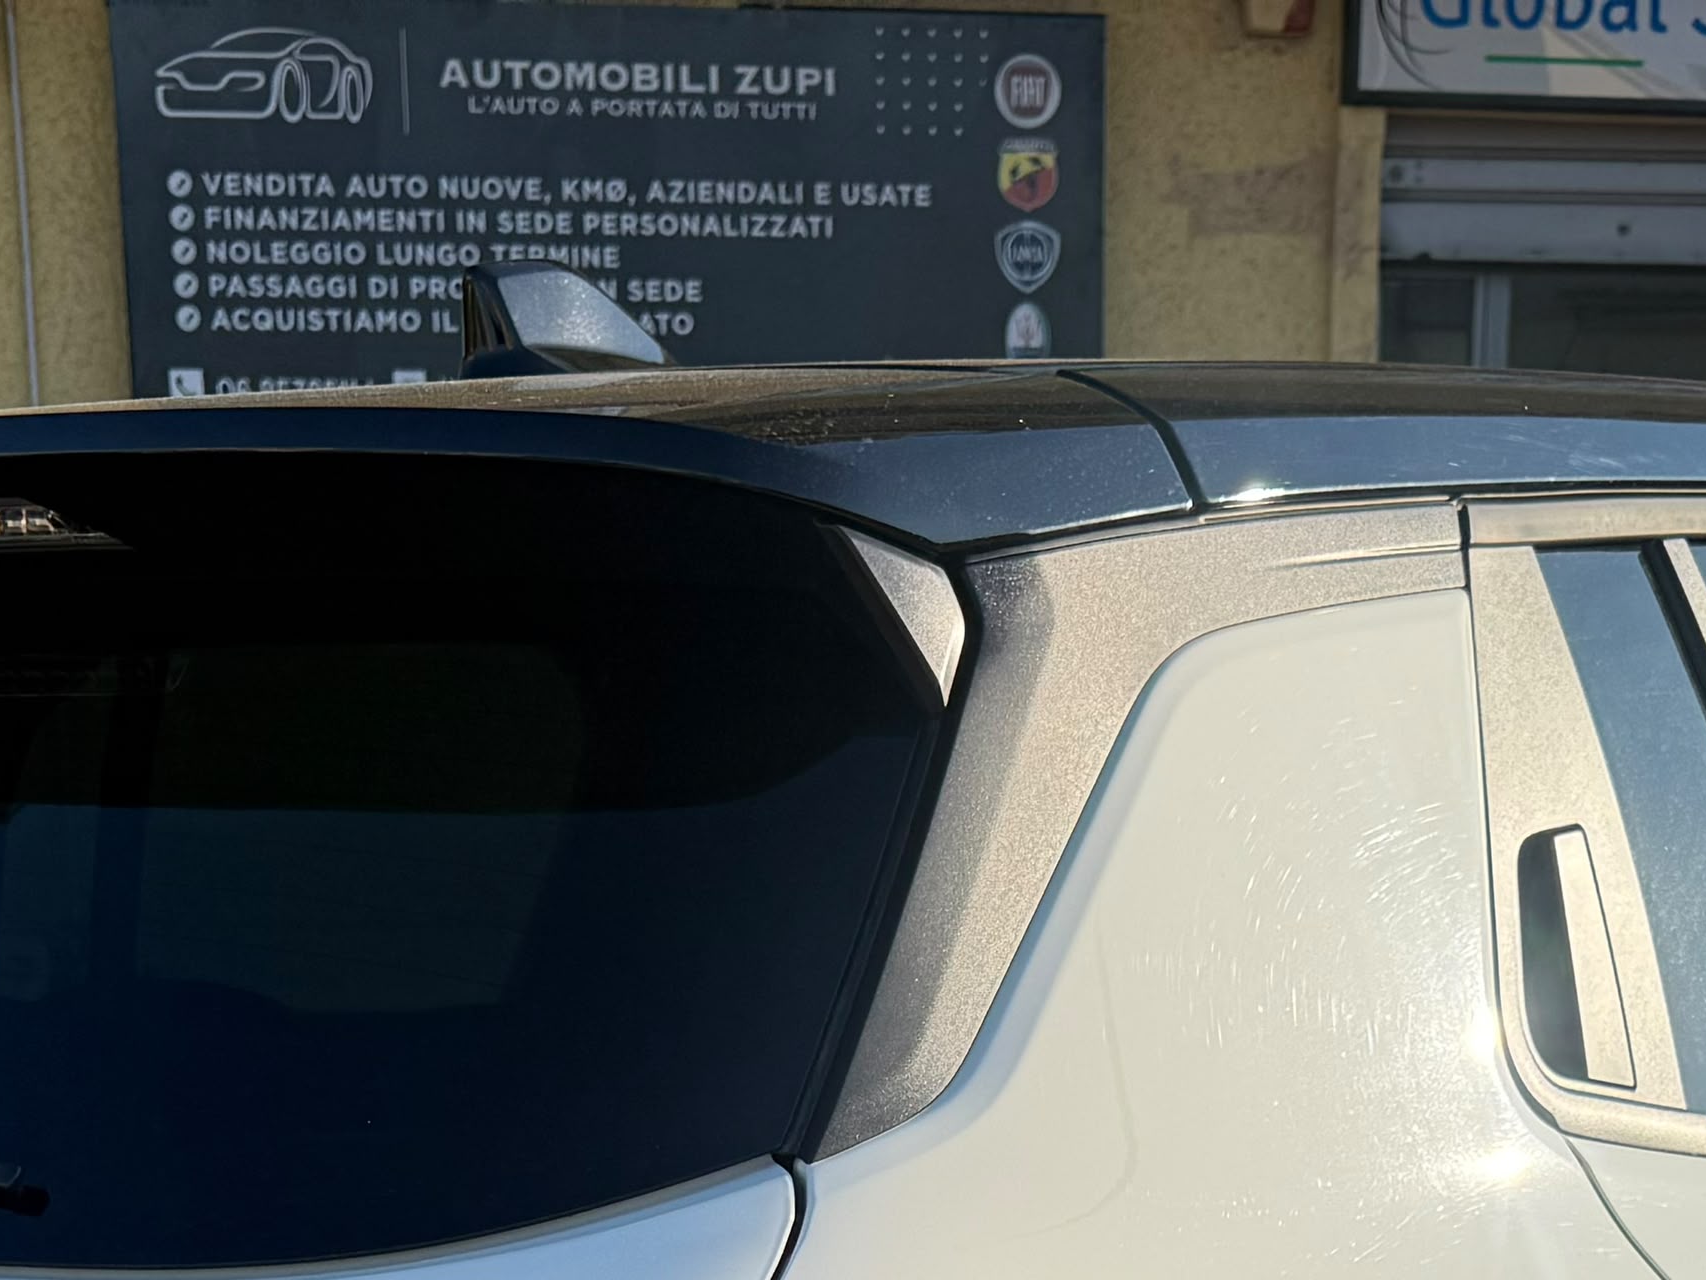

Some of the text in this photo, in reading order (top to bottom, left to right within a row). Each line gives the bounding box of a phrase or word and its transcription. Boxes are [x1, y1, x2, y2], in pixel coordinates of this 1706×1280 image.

[439, 58, 837, 97] AUTOMOBILI ZUPI
[467, 96, 817, 122] L'AUTO A PORTATA DI TUTTI
[200, 171, 337, 199] VENDITA
[345, 174, 429, 200] AUTO
[437, 174, 552, 205] NUOVE,
[645, 180, 804, 205] AZIENDALI
[813, 183, 831, 206] E
[840, 183, 932, 208] USATE
[203, 205, 834, 239] FINANZIAMENTI IN SEDE PERSONALIZZATI
[205, 239, 621, 269] NOLEGGIO LUNGO TERMINE
[207, 274, 358, 299] PASSAGGI
[367, 276, 400, 299] DI
[626, 279, 704, 304] SEDE
[210, 306, 423, 334] ACQUISTIAMO
[430, 309, 459, 334] IL
